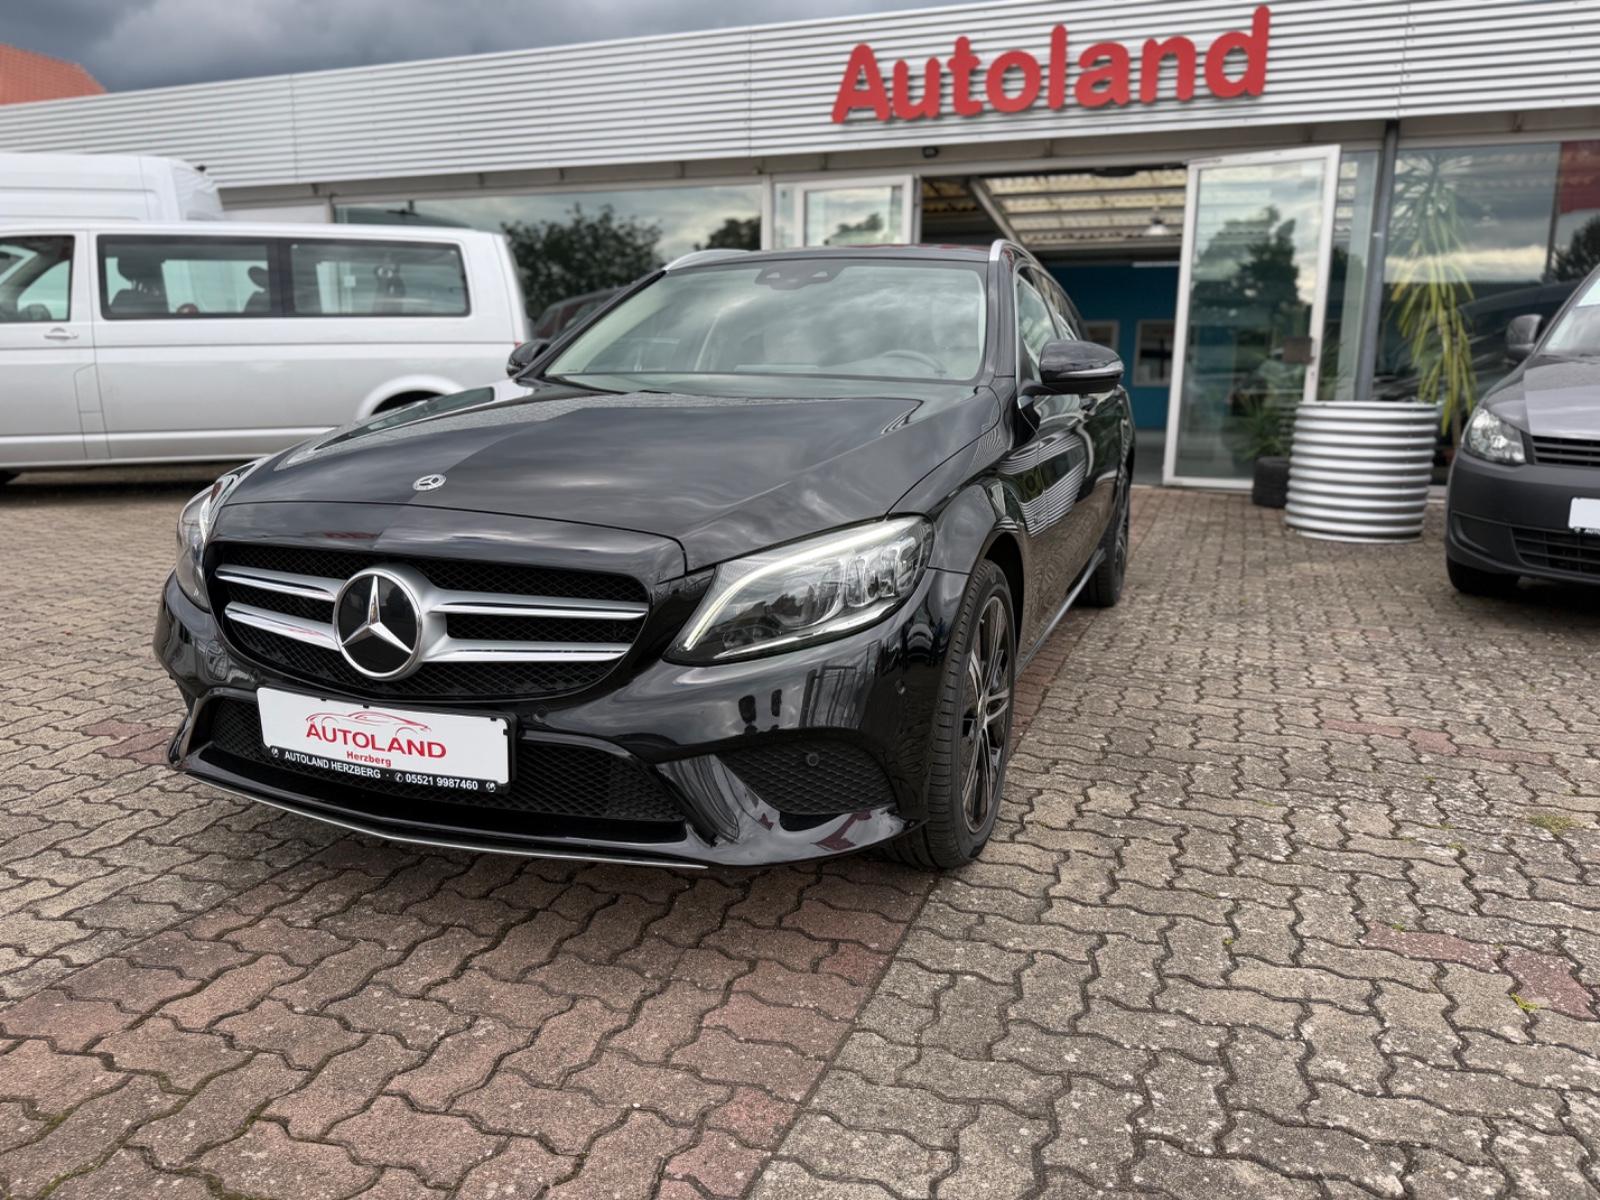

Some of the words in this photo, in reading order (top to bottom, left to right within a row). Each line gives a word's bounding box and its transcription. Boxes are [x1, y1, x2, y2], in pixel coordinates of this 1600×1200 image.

[831, 5, 1271, 124] Autoland
[306, 723, 447, 758] AUTOLAND
[346, 751, 392, 767] Herzberg
[284, 751, 329, 769] AUTOLAND
[331, 761, 381, 779] HERZBERG
[405, 773, 434, 786] 05521
[436, 776, 479, 791] 9987460
